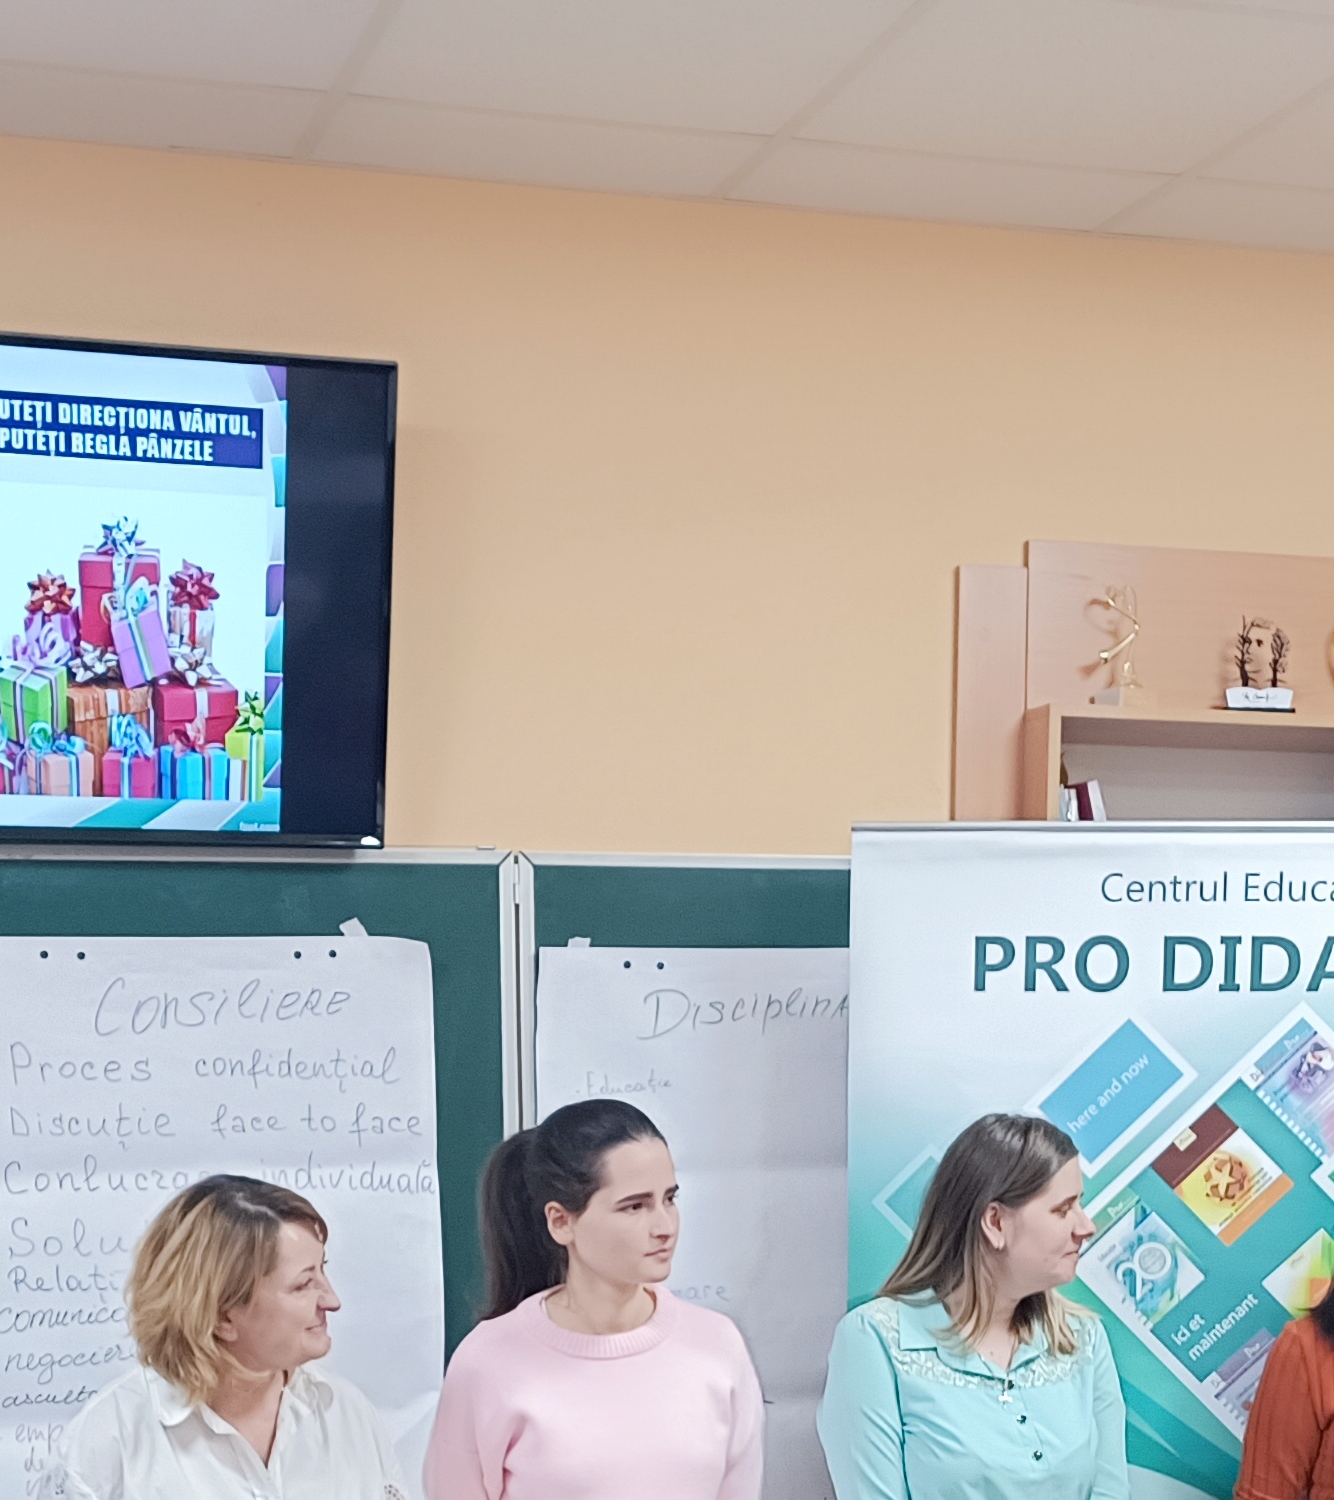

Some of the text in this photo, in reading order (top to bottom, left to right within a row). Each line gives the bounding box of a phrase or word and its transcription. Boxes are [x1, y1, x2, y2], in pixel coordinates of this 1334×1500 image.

[71, 432, 132, 457] REGLA
[136, 432, 214, 462] PÂNZELE
[1099, 870, 1230, 905] Centrul
[973, 934, 1131, 994] PRO
[9, 1041, 153, 1085] Proces
[1066, 1052, 1151, 1135] here and now
[210, 1104, 287, 1138] face
[300, 1102, 338, 1135] to
[348, 1101, 424, 1146] face
[8, 1216, 130, 1258] Solu
[1188, 1313, 1206, 1332] et
[1188, 1293, 1259, 1362] maintenant
